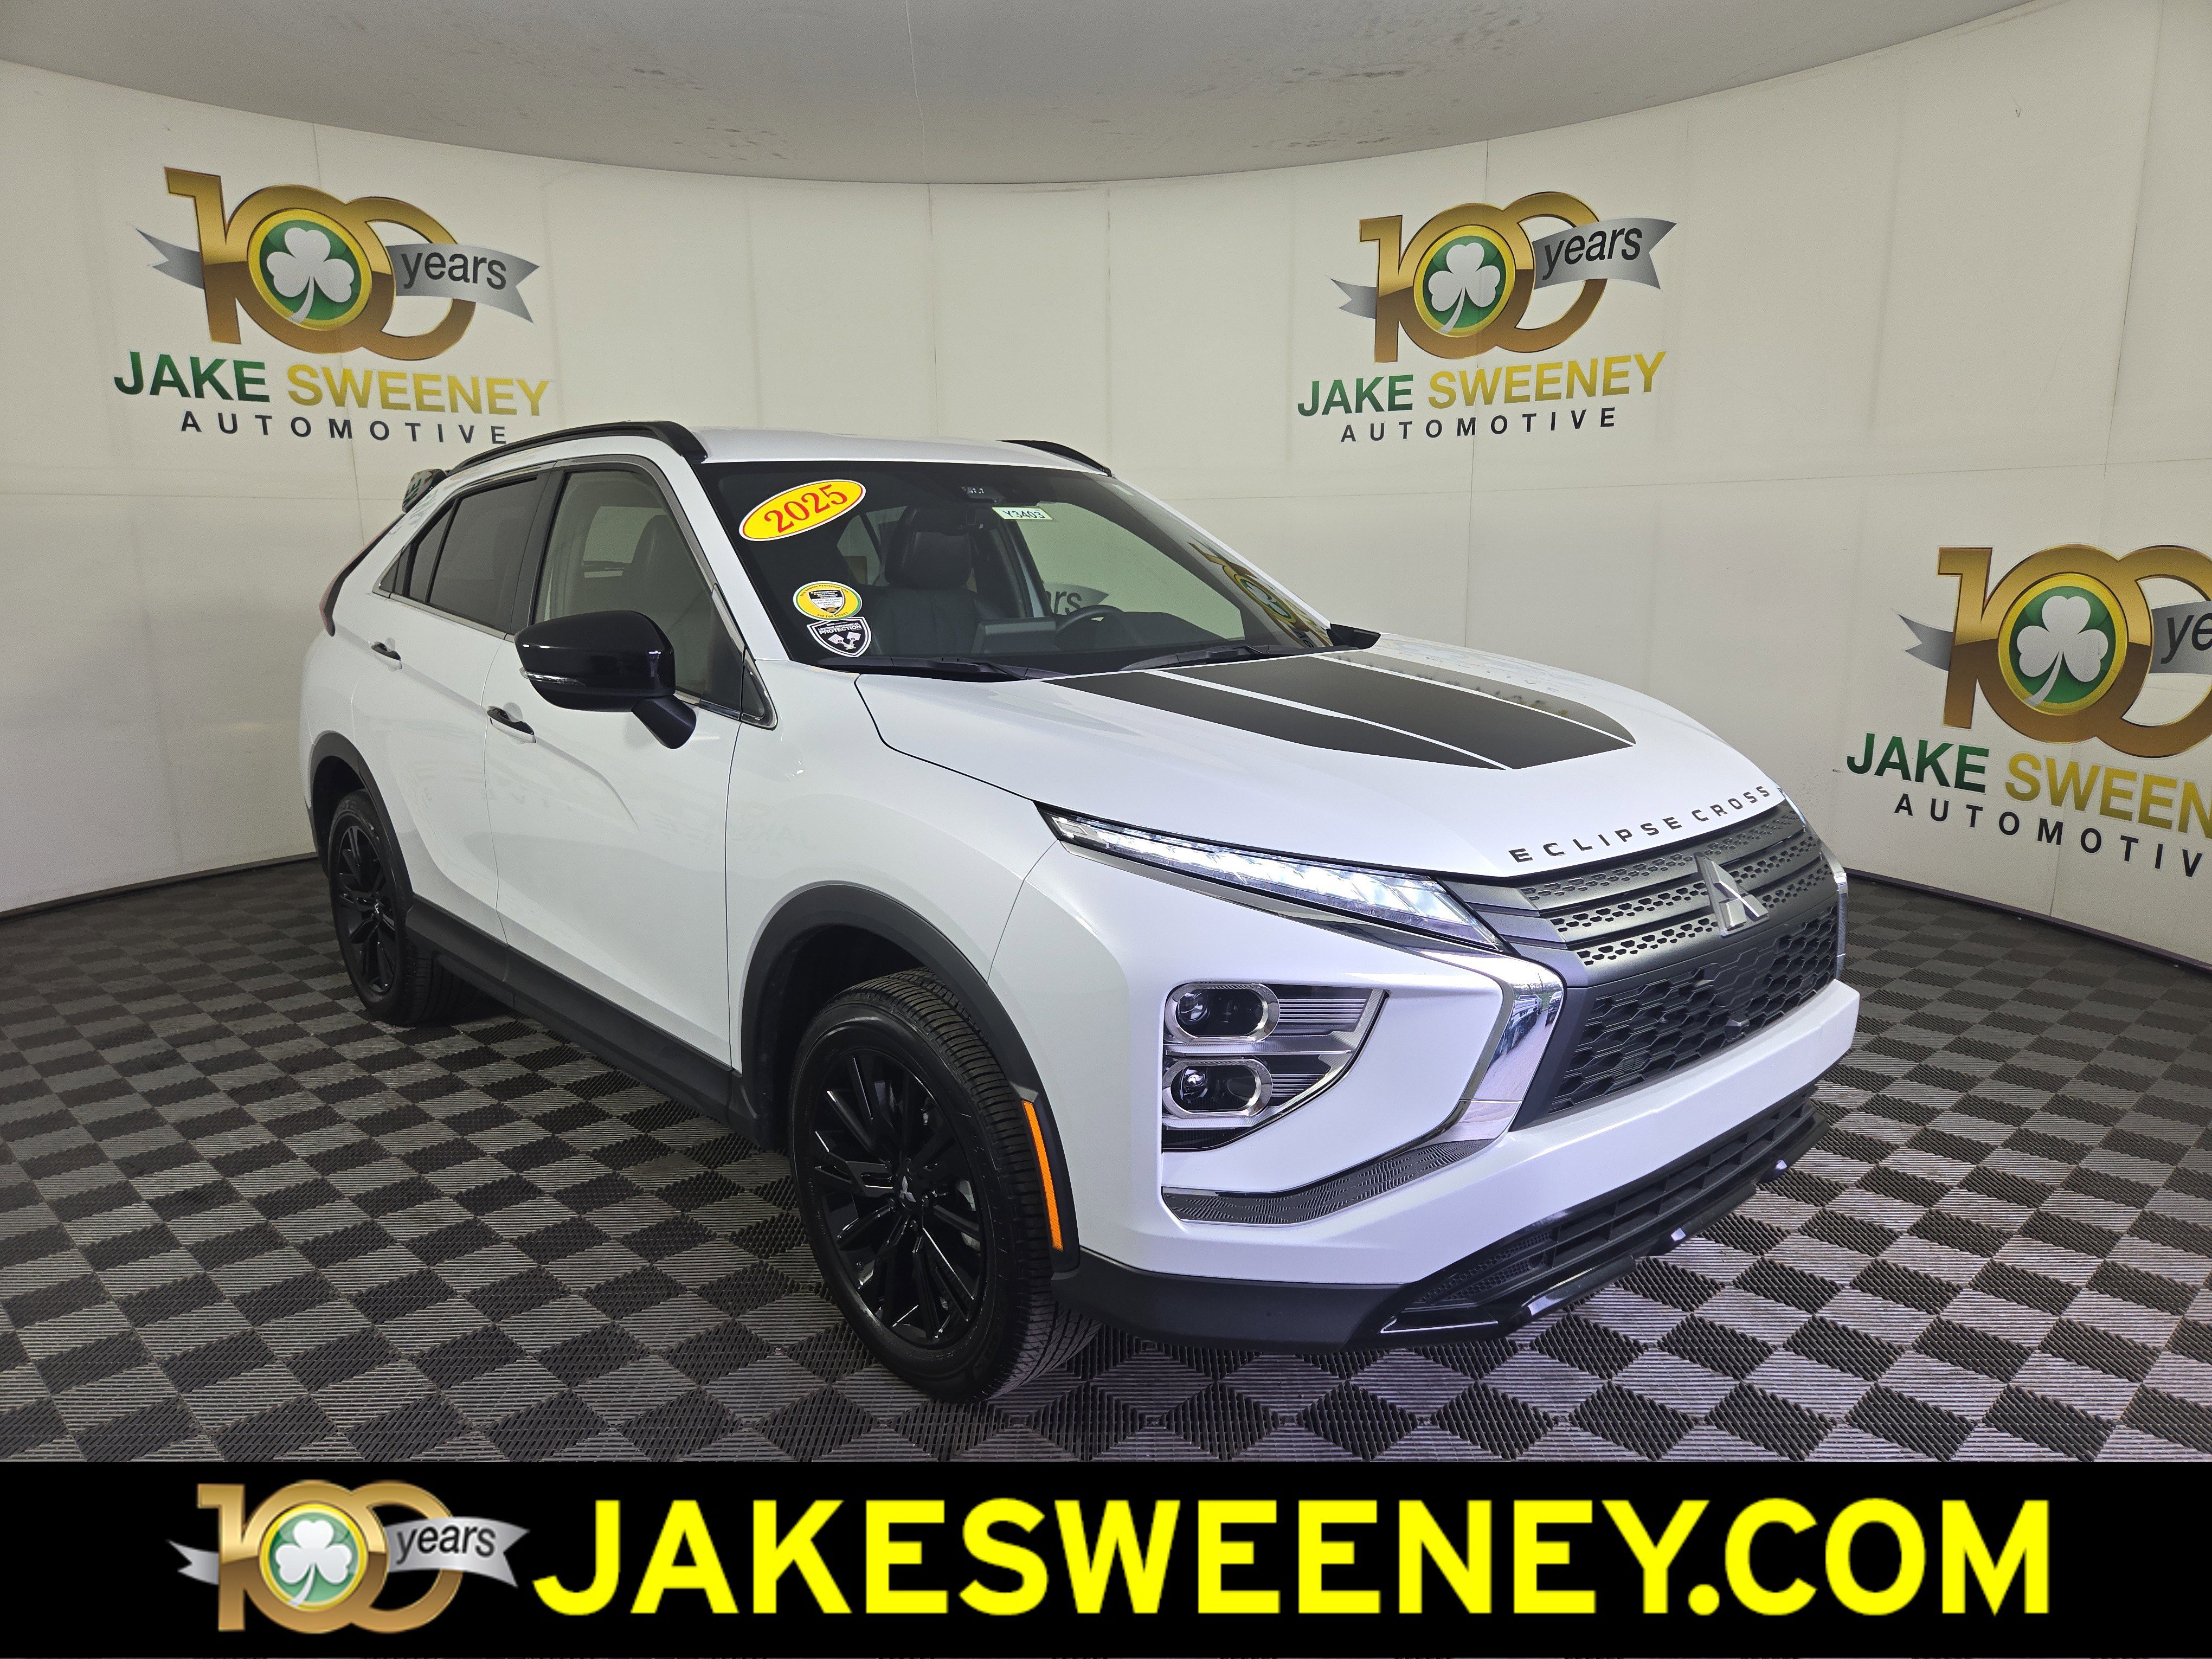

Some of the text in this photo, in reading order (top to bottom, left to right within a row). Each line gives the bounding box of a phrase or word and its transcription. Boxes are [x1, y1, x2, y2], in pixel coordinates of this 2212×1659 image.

[164, 166, 507, 361] 100 years
[1359, 191, 1643, 363] 100 years
[113, 351, 550, 416] JAKE SWEENEY
[1297, 351, 1667, 417] JAKE SWEENEY
[181, 410, 507, 445] AUTOMOTIVE
[1340, 407, 1616, 443] AUTOMOTIVE
[764, 484, 848, 533] 2025
[1001, 510, 1045, 519] Y3403
[819, 625, 863, 634] PROTECTION
[1846, 732, 1989, 793] JAKE
[1508, 786, 1770, 863] ECLIPSE CROSS
[1894, 793, 2203, 878] AUTOMOTIV
